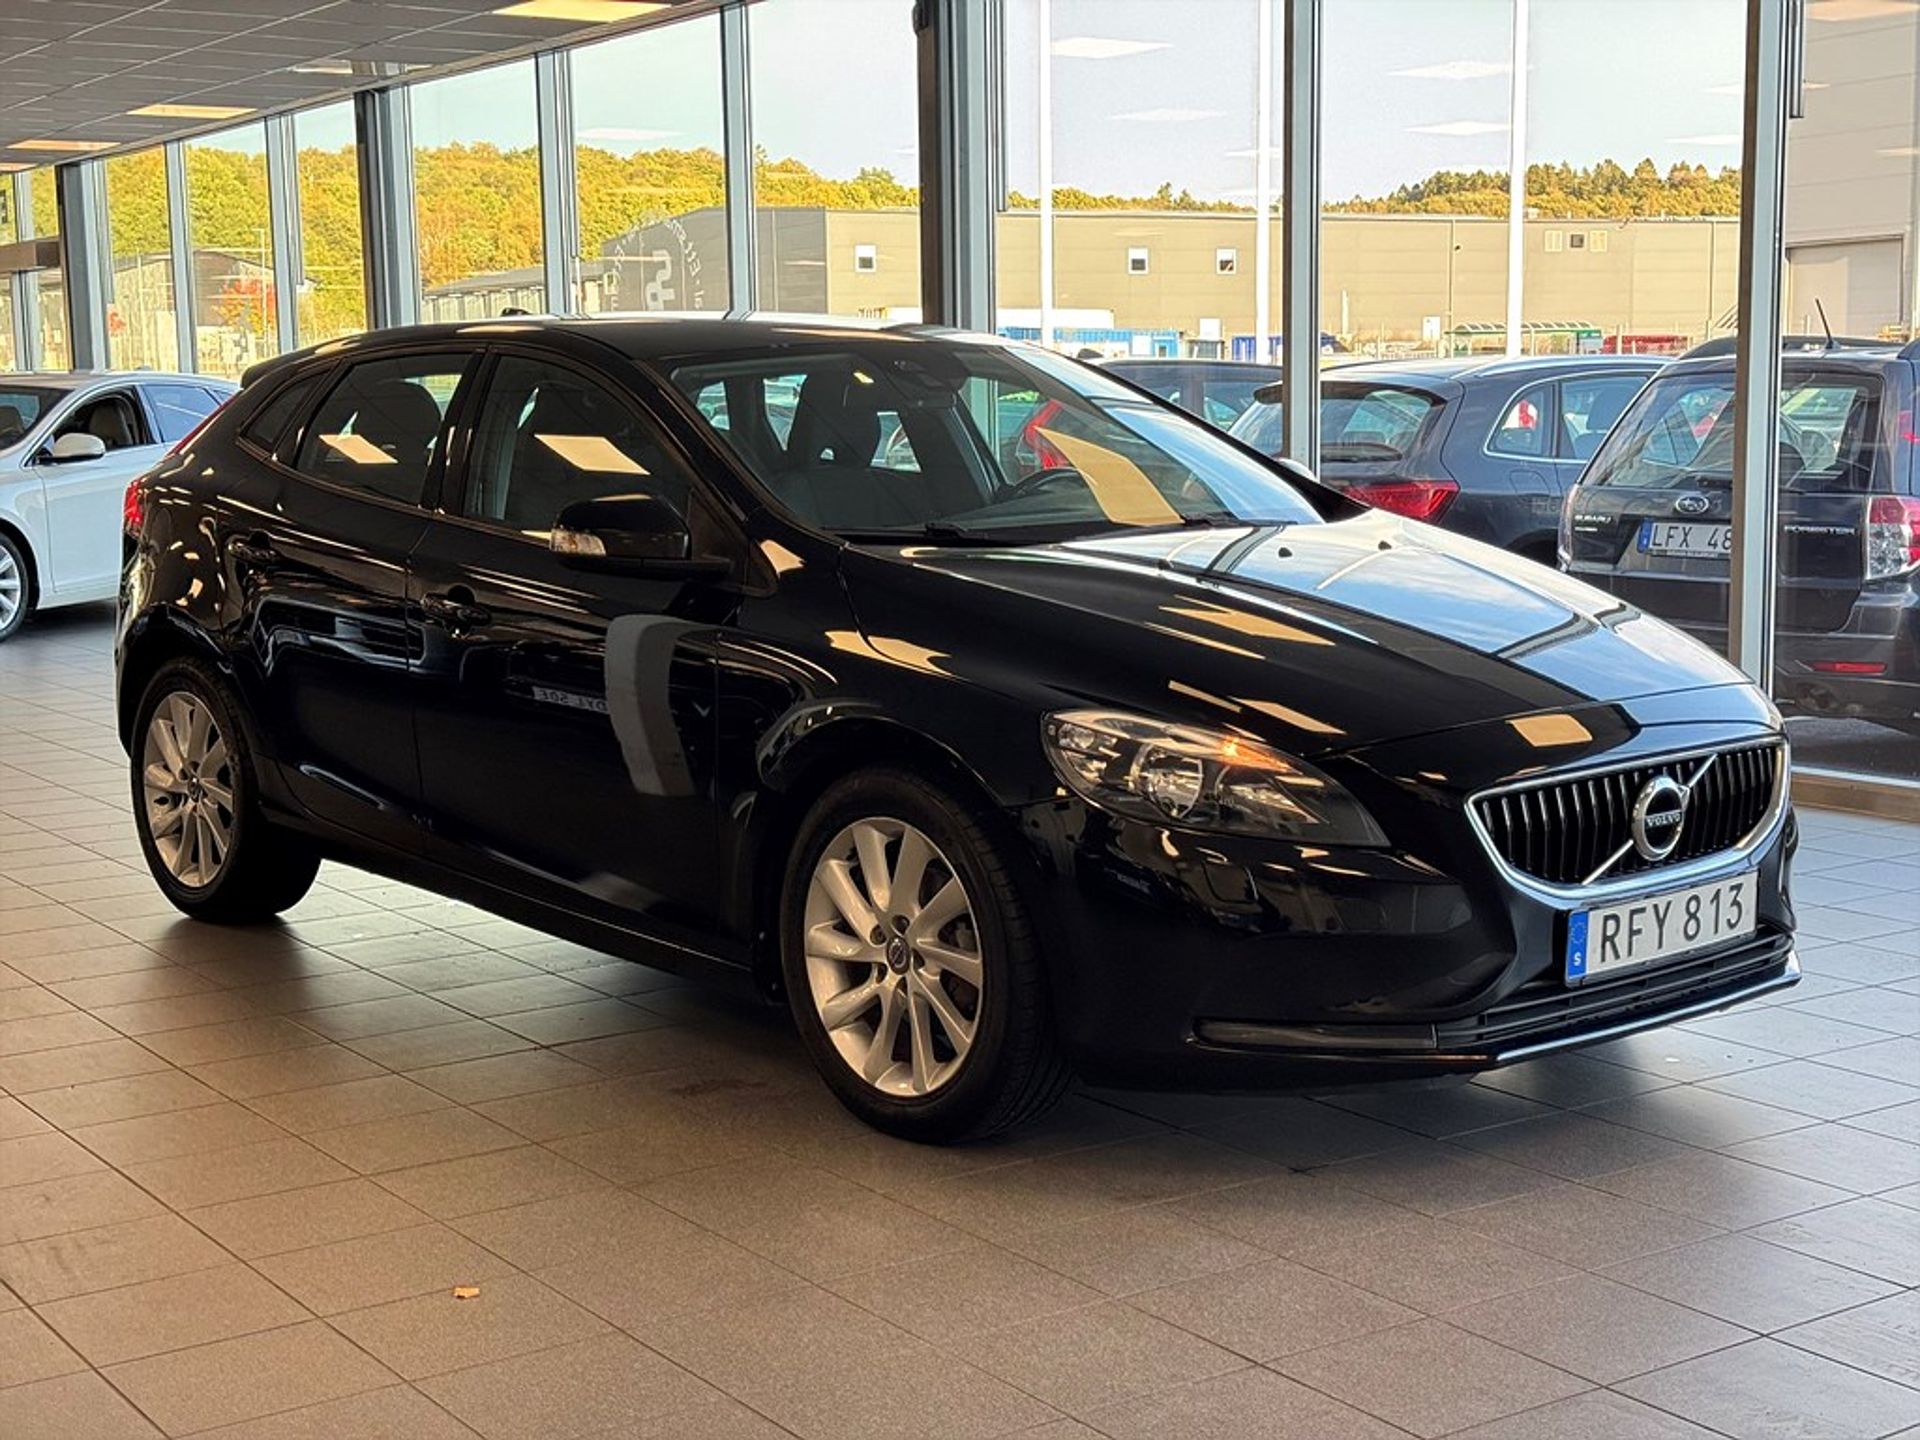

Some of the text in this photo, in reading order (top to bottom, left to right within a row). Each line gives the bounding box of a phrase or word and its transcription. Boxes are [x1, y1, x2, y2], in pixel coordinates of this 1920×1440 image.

[1652, 525, 1732, 551] LFX 48
[1647, 811, 1682, 828] VOLVO
[1573, 883, 1744, 966] S RFY 813
